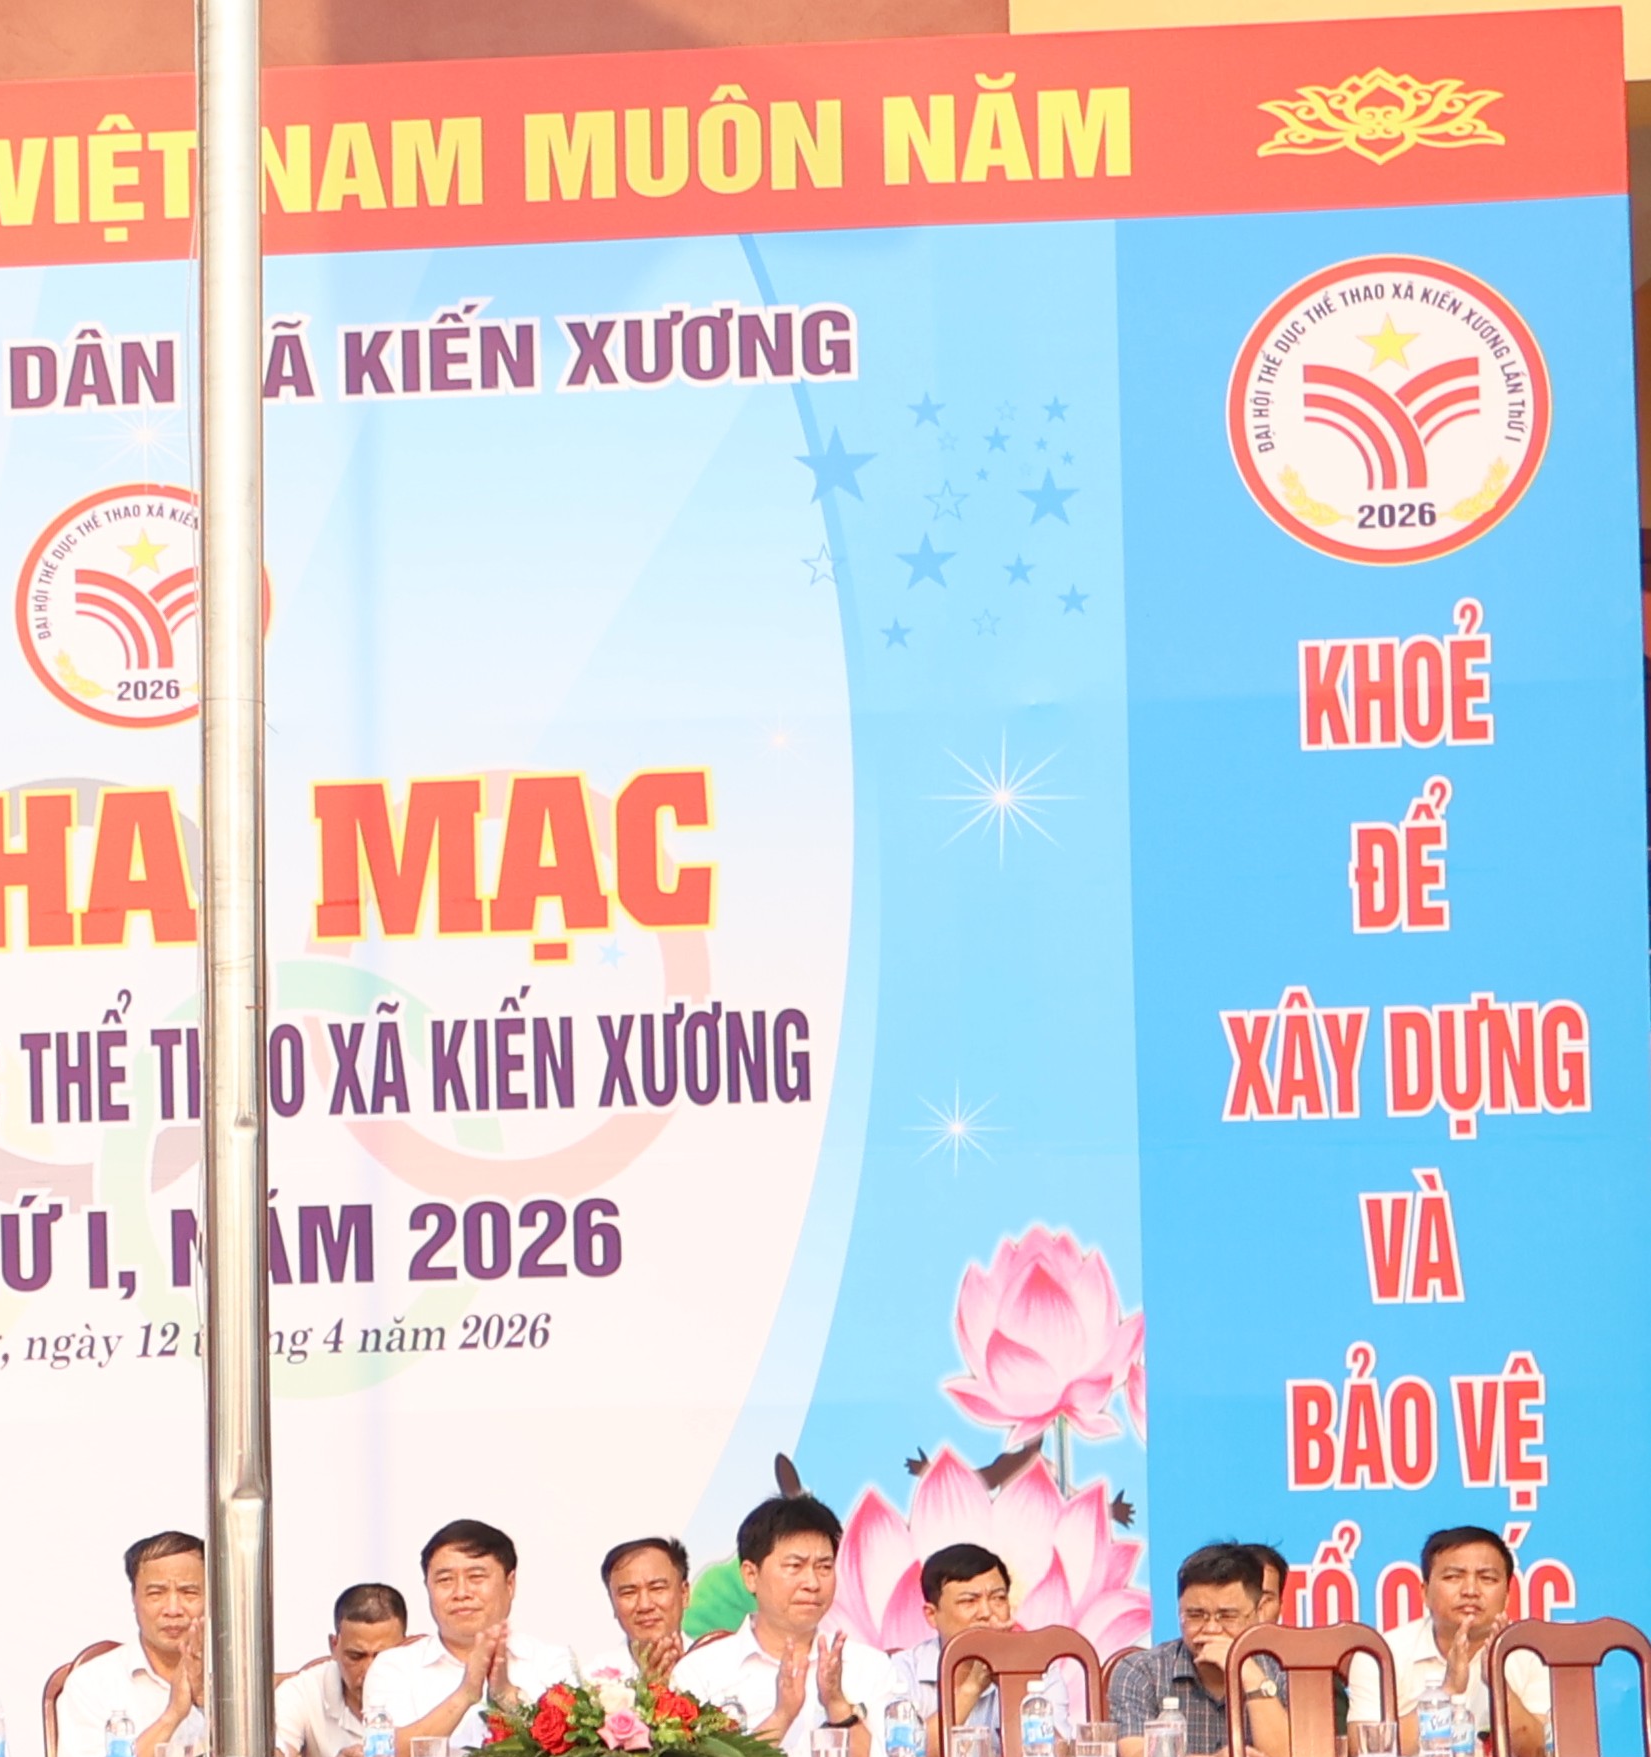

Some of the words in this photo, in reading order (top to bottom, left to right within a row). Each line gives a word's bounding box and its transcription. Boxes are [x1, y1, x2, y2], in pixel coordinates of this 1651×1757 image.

[262, 116, 484, 215] NAM
[523, 84, 843, 203] MUÔN
[883, 71, 1132, 189] NĂM
[1303, 290, 1338, 325] THỂ
[1338, 284, 1385, 307] THAO
[1392, 280, 1414, 300] XÃ
[1420, 289, 1463, 316] KIẾN
[1274, 320, 1307, 354] DỤC
[1461, 307, 1511, 361] XƯƠNG
[9, 327, 176, 410] DÂN
[262, 319, 316, 399] Ã
[344, 303, 535, 395] KIẾN
[566, 306, 853, 387] XƯƠNG
[1257, 349, 1283, 385] THỂ
[1250, 389, 1275, 418] HỘI
[1253, 424, 1277, 453] ĐẠI
[104, 504, 141, 524] THAO
[146, 502, 165, 518] XÃ
[1357, 501, 1438, 529] 2026
[52, 533, 78, 562] DỤC
[31, 589, 50, 613] HỘI
[35, 614, 52, 641] ĐẠI
[117, 679, 180, 702] 2026
[1301, 602, 1491, 748] KHOẺ
[312, 767, 717, 966] MẠC
[1352, 778, 1447, 931] ĐỂ
[20, 988, 130, 1124] THỂ
[150, 1022, 306, 1121] TO
[328, 1001, 411, 1117] XÃ
[431, 985, 575, 1113] KIẾN
[597, 1001, 812, 1110] XƯƠNG
[1223, 988, 1367, 1120] XÂY
[1386, 995, 1589, 1137] DỰNG
[87, 1211, 138, 1301] I,
[407, 1199, 624, 1283] 2026
[1362, 1171, 1462, 1302] VÀ
[23, 1325, 125, 1369] ngày
[134, 1322, 181, 1360] 12
[194, 1326, 313, 1364] tng
[322, 1318, 346, 1355] 4
[358, 1313, 446, 1354] năm
[458, 1313, 552, 1351] 2026
[1289, 1343, 1436, 1489] BẢO
[1453, 1354, 1545, 1508] VỆ
